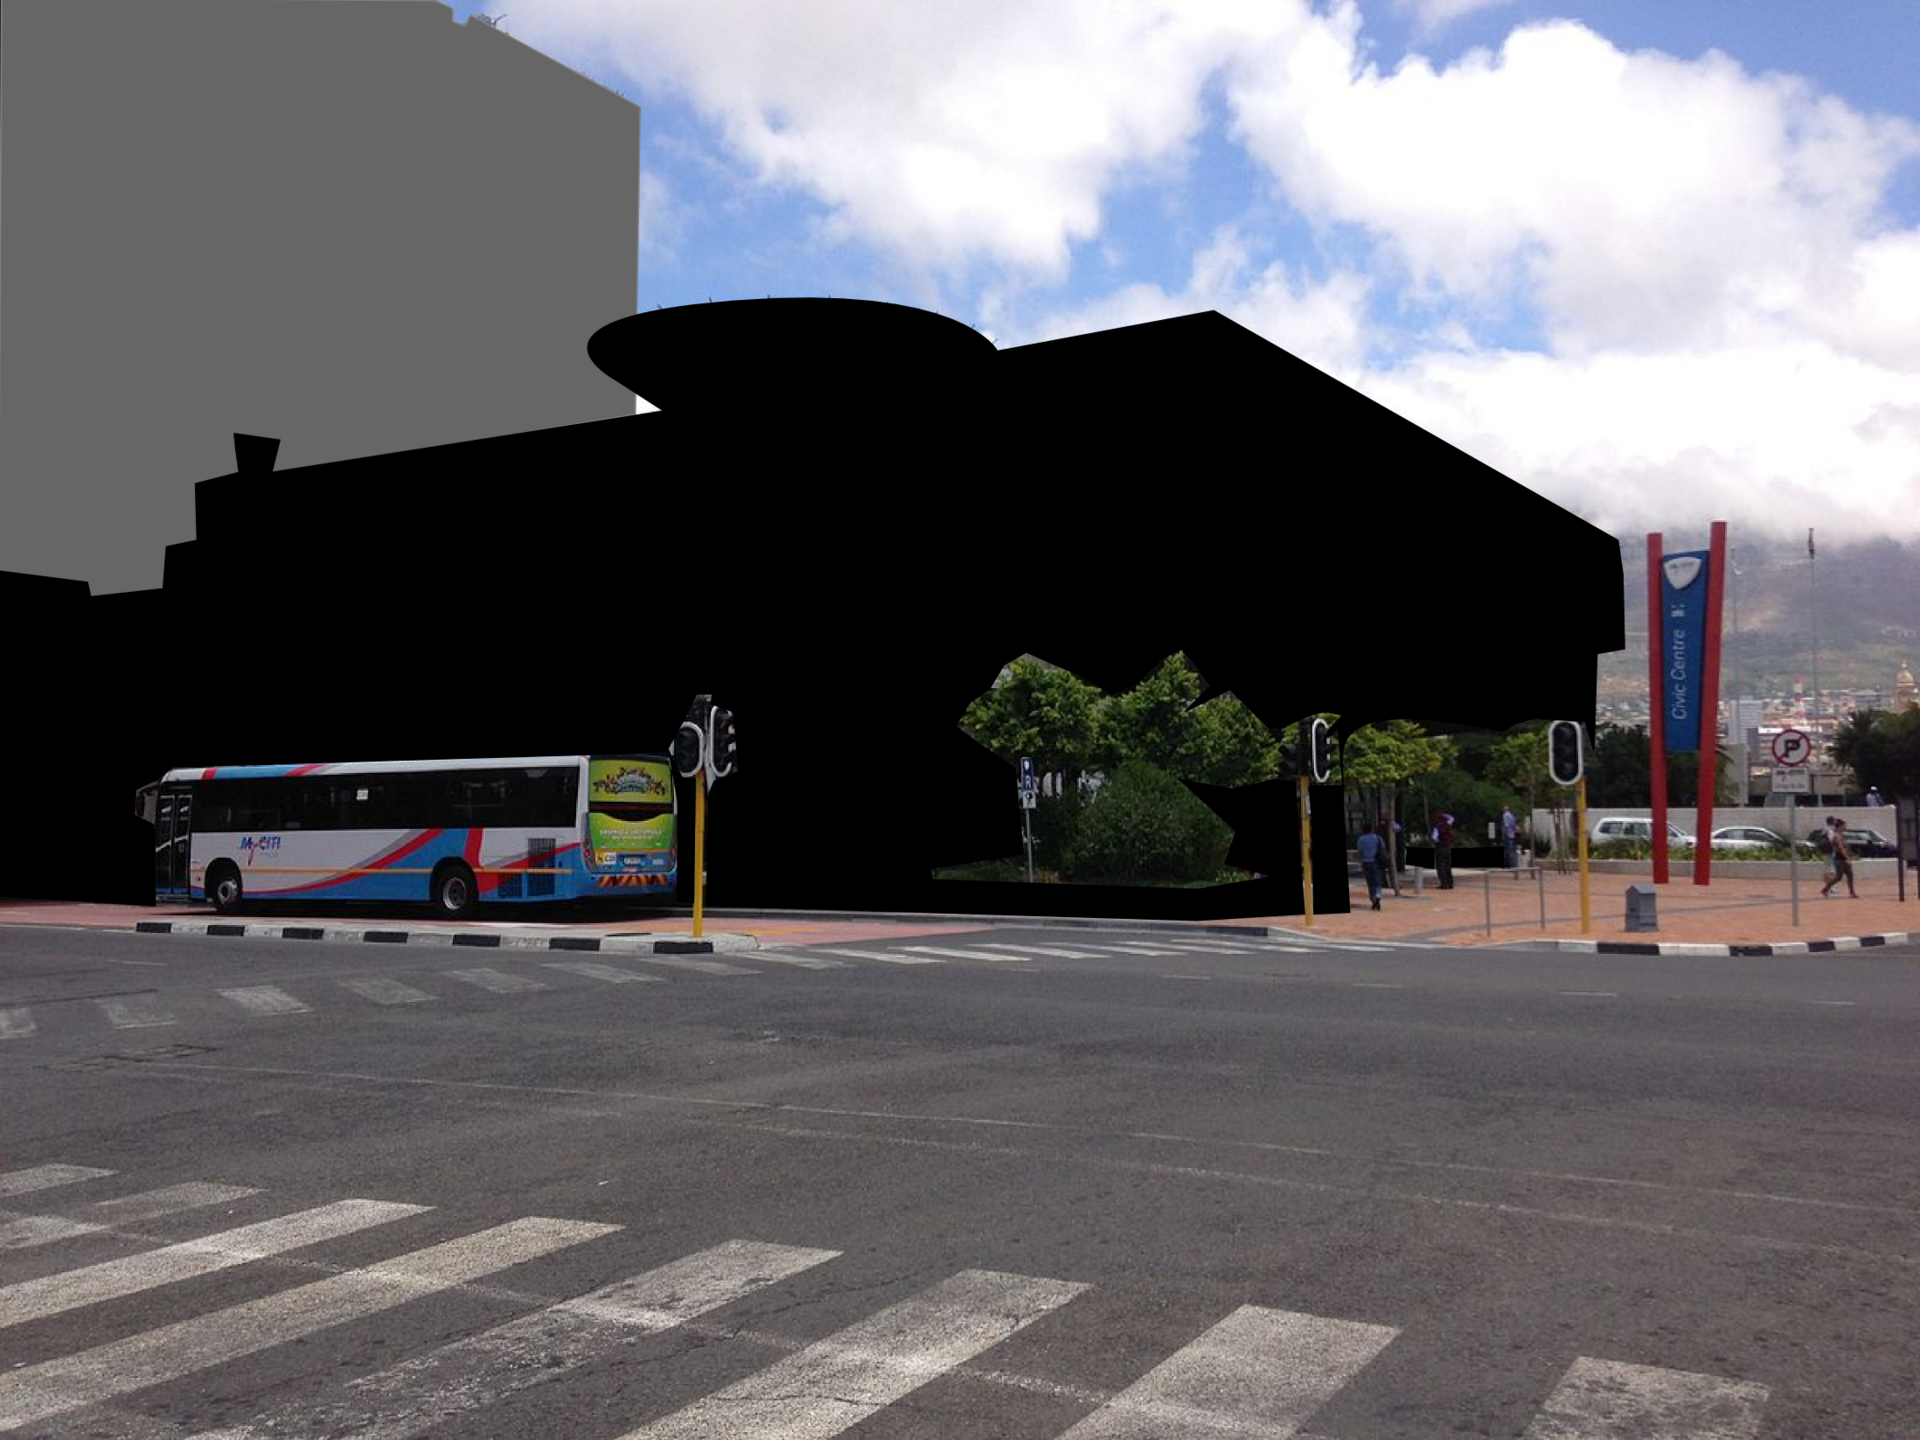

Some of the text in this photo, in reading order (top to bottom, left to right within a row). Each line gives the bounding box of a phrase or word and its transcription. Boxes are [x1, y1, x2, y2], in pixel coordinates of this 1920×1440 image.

[1670, 629, 1687, 720] Civic Centre
[1784, 739, 1800, 758] P
